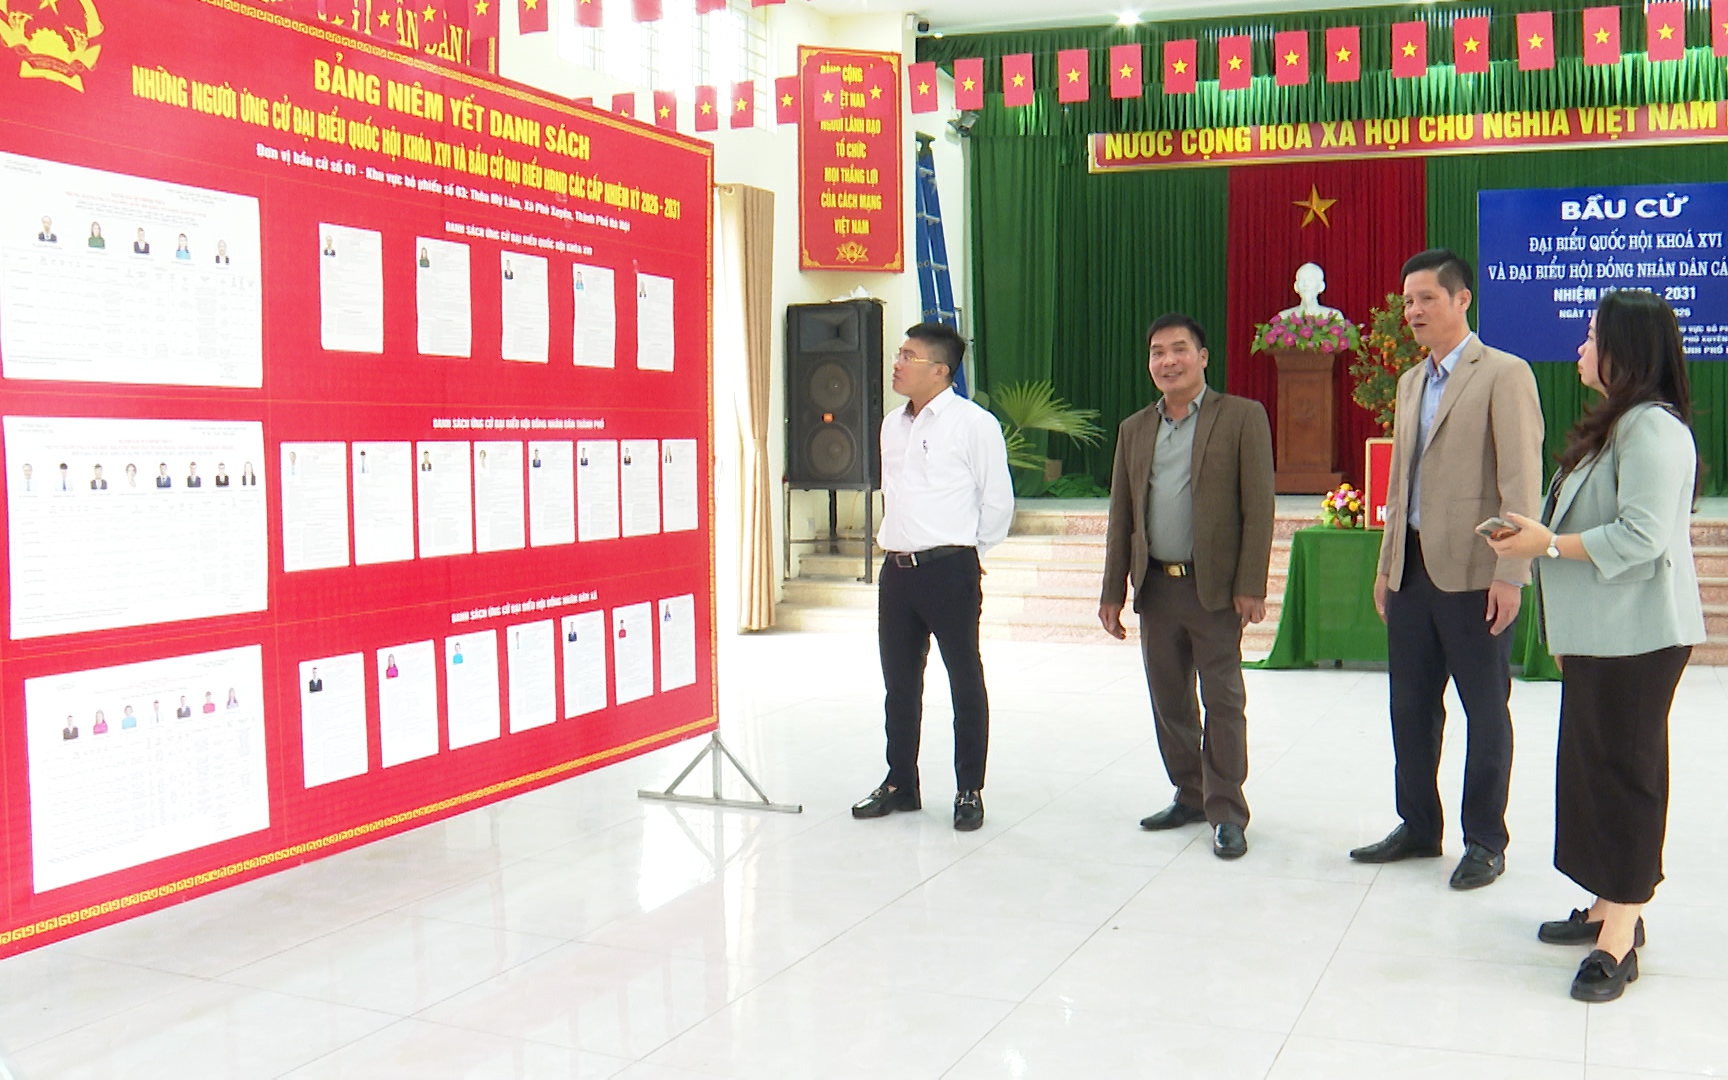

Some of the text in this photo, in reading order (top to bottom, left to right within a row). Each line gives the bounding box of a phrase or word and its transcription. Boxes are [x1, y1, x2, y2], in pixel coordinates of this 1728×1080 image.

[313, 52, 590, 160] BẢNG NIÊM YẾT DANH SÁCH
[1647, 101, 1717, 132] NAM
[131, 65, 188, 108] NHỮNG
[191, 81, 237, 120] NGƯỜI
[240, 87, 269, 127] ỨNG
[272, 94, 291, 133] CỬ
[293, 106, 315, 142] ĐẠI
[318, 106, 346, 145] BIỂU
[349, 116, 380, 151] QUỐC
[382, 125, 401, 162] HỘI
[403, 132, 432, 164] KHÓA
[434, 141, 451, 168] XVI
[453, 142, 467, 172] VÀ
[490, 148, 504, 180] CỬ
[505, 158, 521, 188] ĐẠI
[522, 156, 543, 189] BIỂU
[569, 171, 585, 199] CÁC
[587, 172, 603, 203] CẤP
[664, 197, 681, 220] 2031
[281, 149, 291, 166] vị
[330, 159, 343, 175] số
[344, 162, 357, 176] 01
[365, 166, 385, 182] Khu
[821, 187, 882, 214] CỦA CÁCH MẠNG
[1635, 192, 1690, 218] CỬ
[834, 215, 870, 238] VIỆT NAM
[1529, 226, 1723, 255] ĐẠI BIỂU QUỐC HỘI KHOÁ XVI
[1488, 261, 1507, 281] VÀ
[1509, 265, 1532, 284] ĐẠI
[1535, 256, 1566, 280] BIỂU
[1569, 259, 1593, 282] HỘI
[1596, 255, 1634, 279] ĐỒNG
[1637, 257, 1677, 278] NHÂN
[1679, 257, 1708, 277] DÂN
[1553, 285, 1597, 304] NHIỆM
[1664, 286, 1696, 300] 2031
